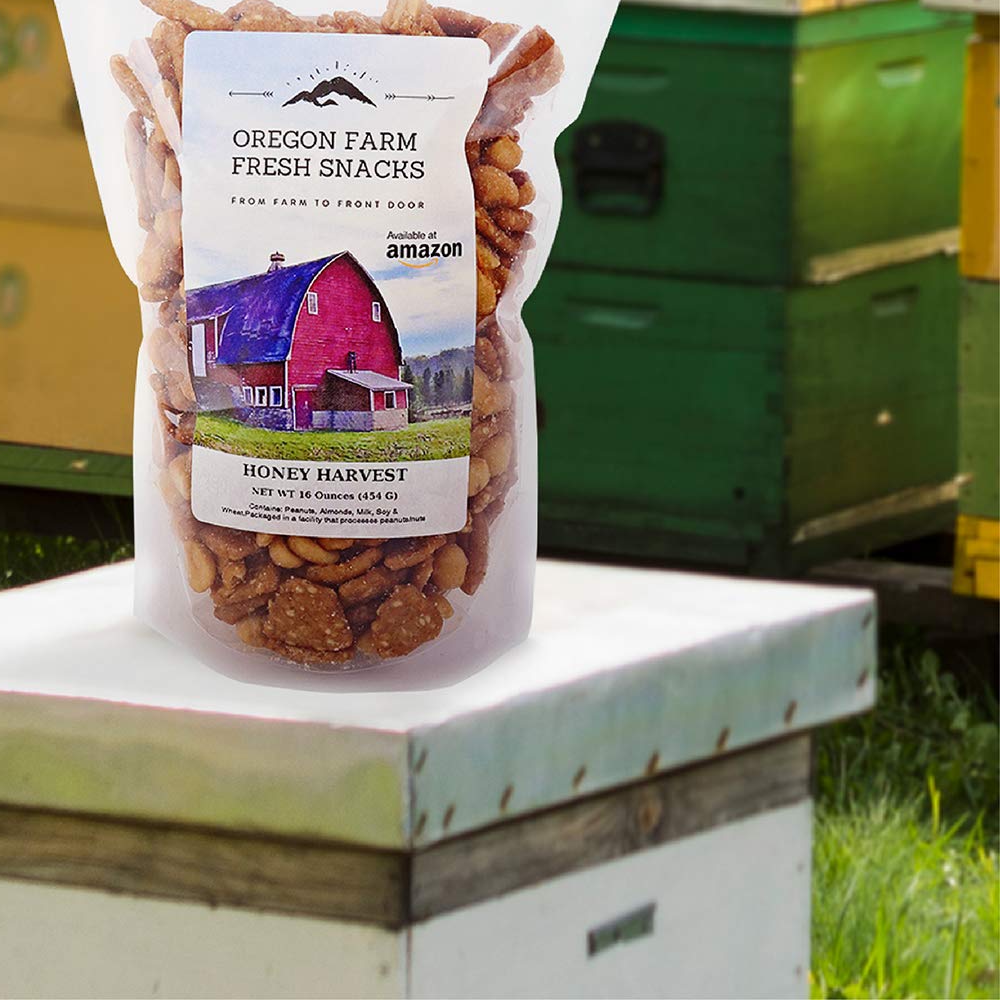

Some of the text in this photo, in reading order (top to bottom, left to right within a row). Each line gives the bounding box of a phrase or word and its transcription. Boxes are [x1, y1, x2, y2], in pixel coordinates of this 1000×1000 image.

[232, 129, 417, 152] OREGON FARM
[231, 156, 425, 179] FRESH SNACKS
[231, 196, 425, 210] FROM FARM TO FRONT DOOR
[386, 230, 437, 240] Available at
[386, 241, 463, 259] amazon
[243, 463, 408, 482] HONEY HARVEST
[252, 486, 398, 501] NET WT 16 Ounces (454 G)
